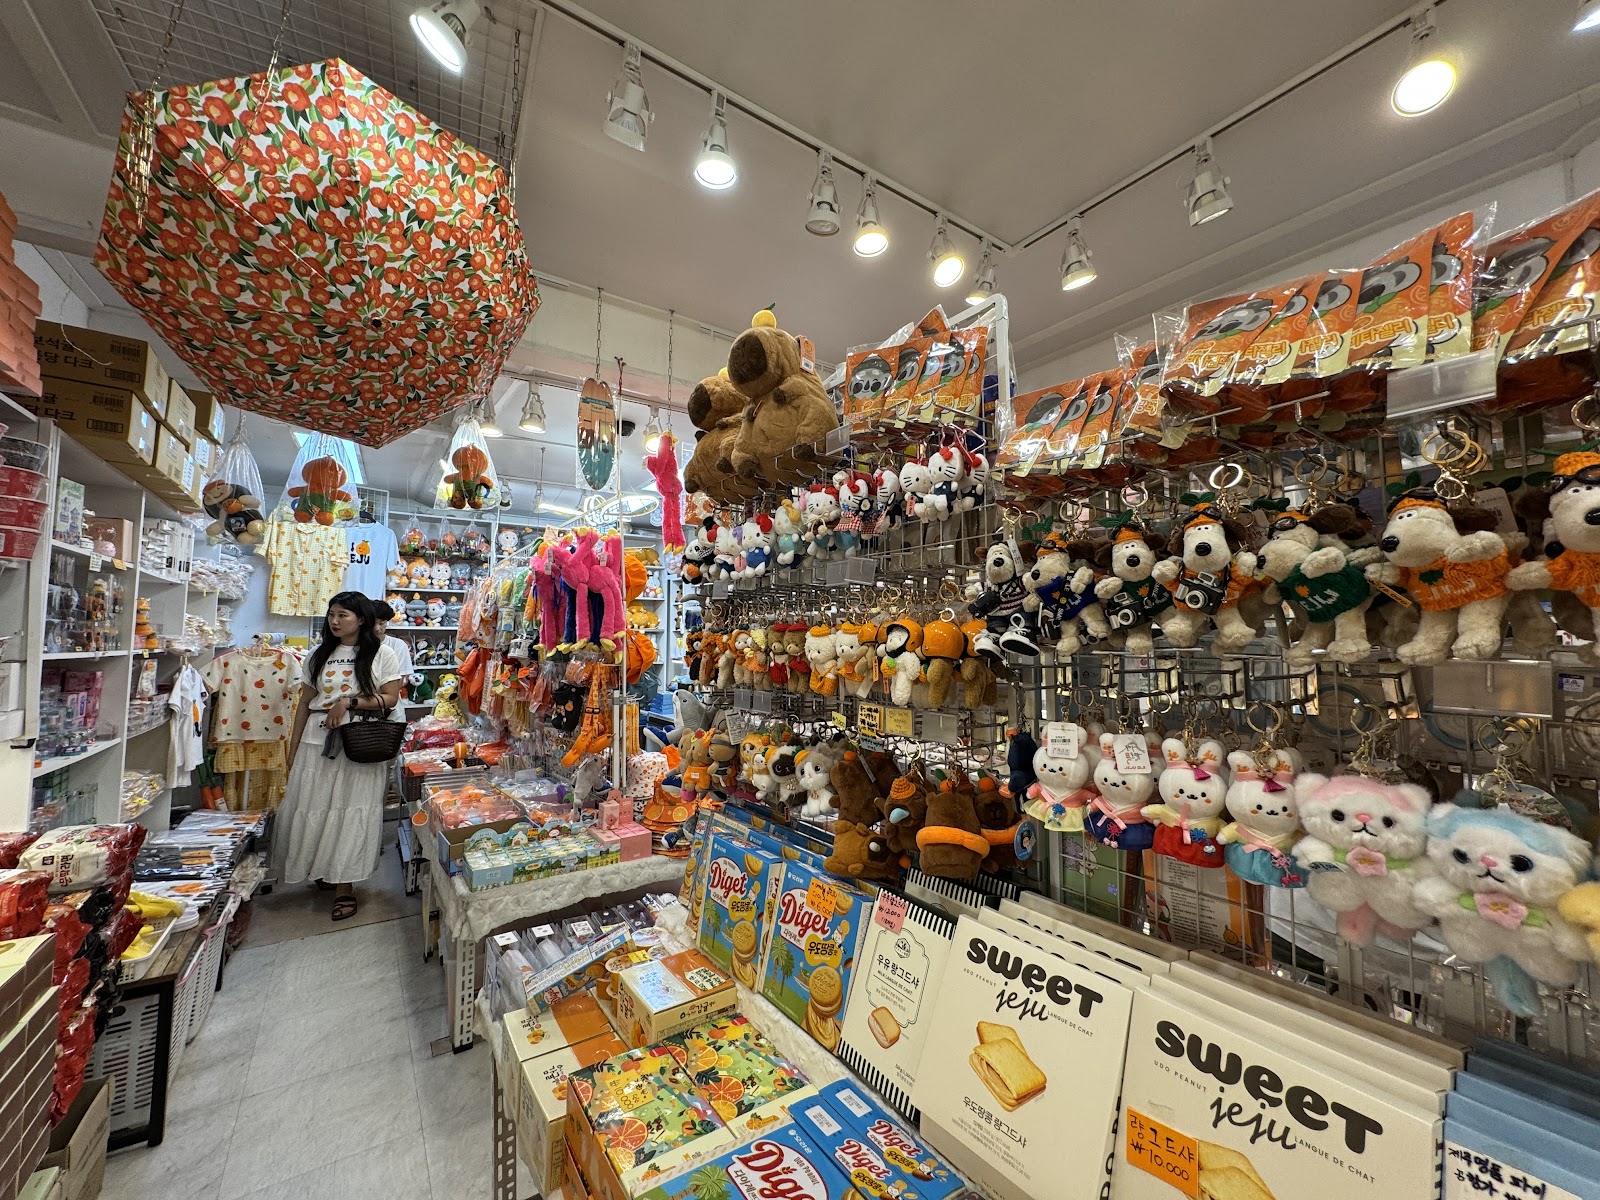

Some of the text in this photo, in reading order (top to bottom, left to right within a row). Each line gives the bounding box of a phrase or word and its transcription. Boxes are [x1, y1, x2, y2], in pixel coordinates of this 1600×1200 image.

[64, 355, 95, 370] 다크
[350, 553, 371, 565] EJU
[709, 861, 748, 899] Diget
[975, 973, 997, 988] PEANUT
[995, 981, 1049, 1021] jeju
[1047, 1010, 1094, 1037] LANGUE DE CHAT
[1153, 1059, 1208, 1093] UDO PEANUT
[962, 1096, 994, 1125] 우도땅콩
[1209, 1086, 1297, 1150] jeju
[795, 1132, 813, 1154] 오리온
[870, 1119, 923, 1157] Diget
[838, 1139, 892, 1180] Diget
[1293, 1136, 1376, 1184] LANGUE DE CHAT
